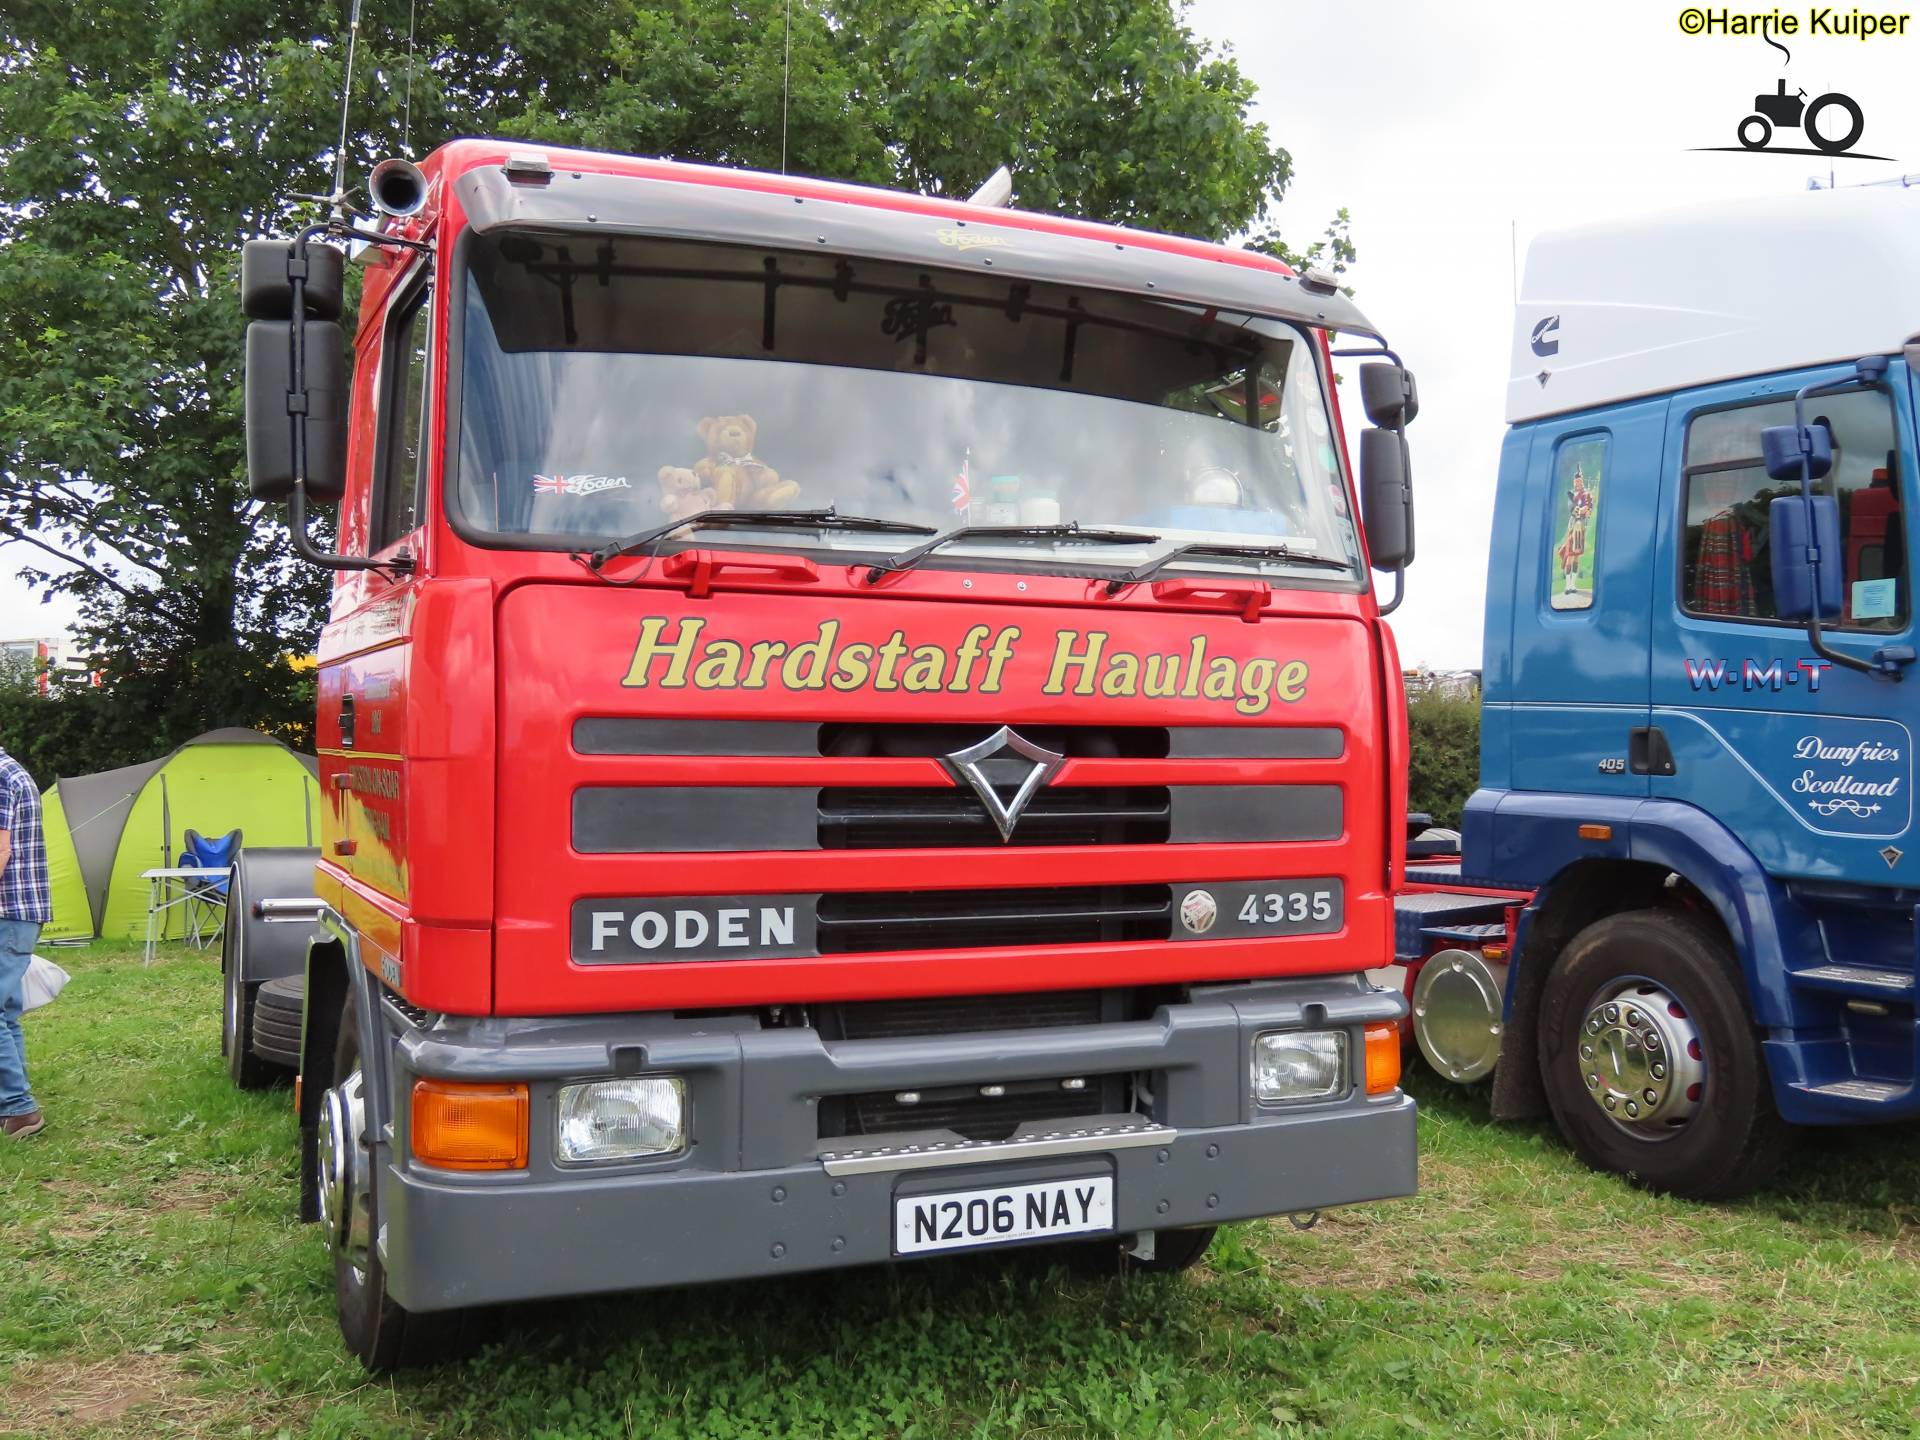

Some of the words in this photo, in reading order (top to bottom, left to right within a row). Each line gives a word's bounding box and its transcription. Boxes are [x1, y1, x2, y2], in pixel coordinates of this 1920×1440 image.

[621, 615, 1021, 694] Hardstaff
[1041, 629, 1310, 715] Haulage
[1599, 758, 1625, 770] 405
[1792, 735, 1901, 766] Dumfries
[1791, 770, 1900, 797] Scotland
[1238, 891, 1332, 924] 4335
[591, 907, 795, 951] FODEN
[914, 1195, 1014, 1243] N206
[1025, 1186, 1096, 1230] NAY
